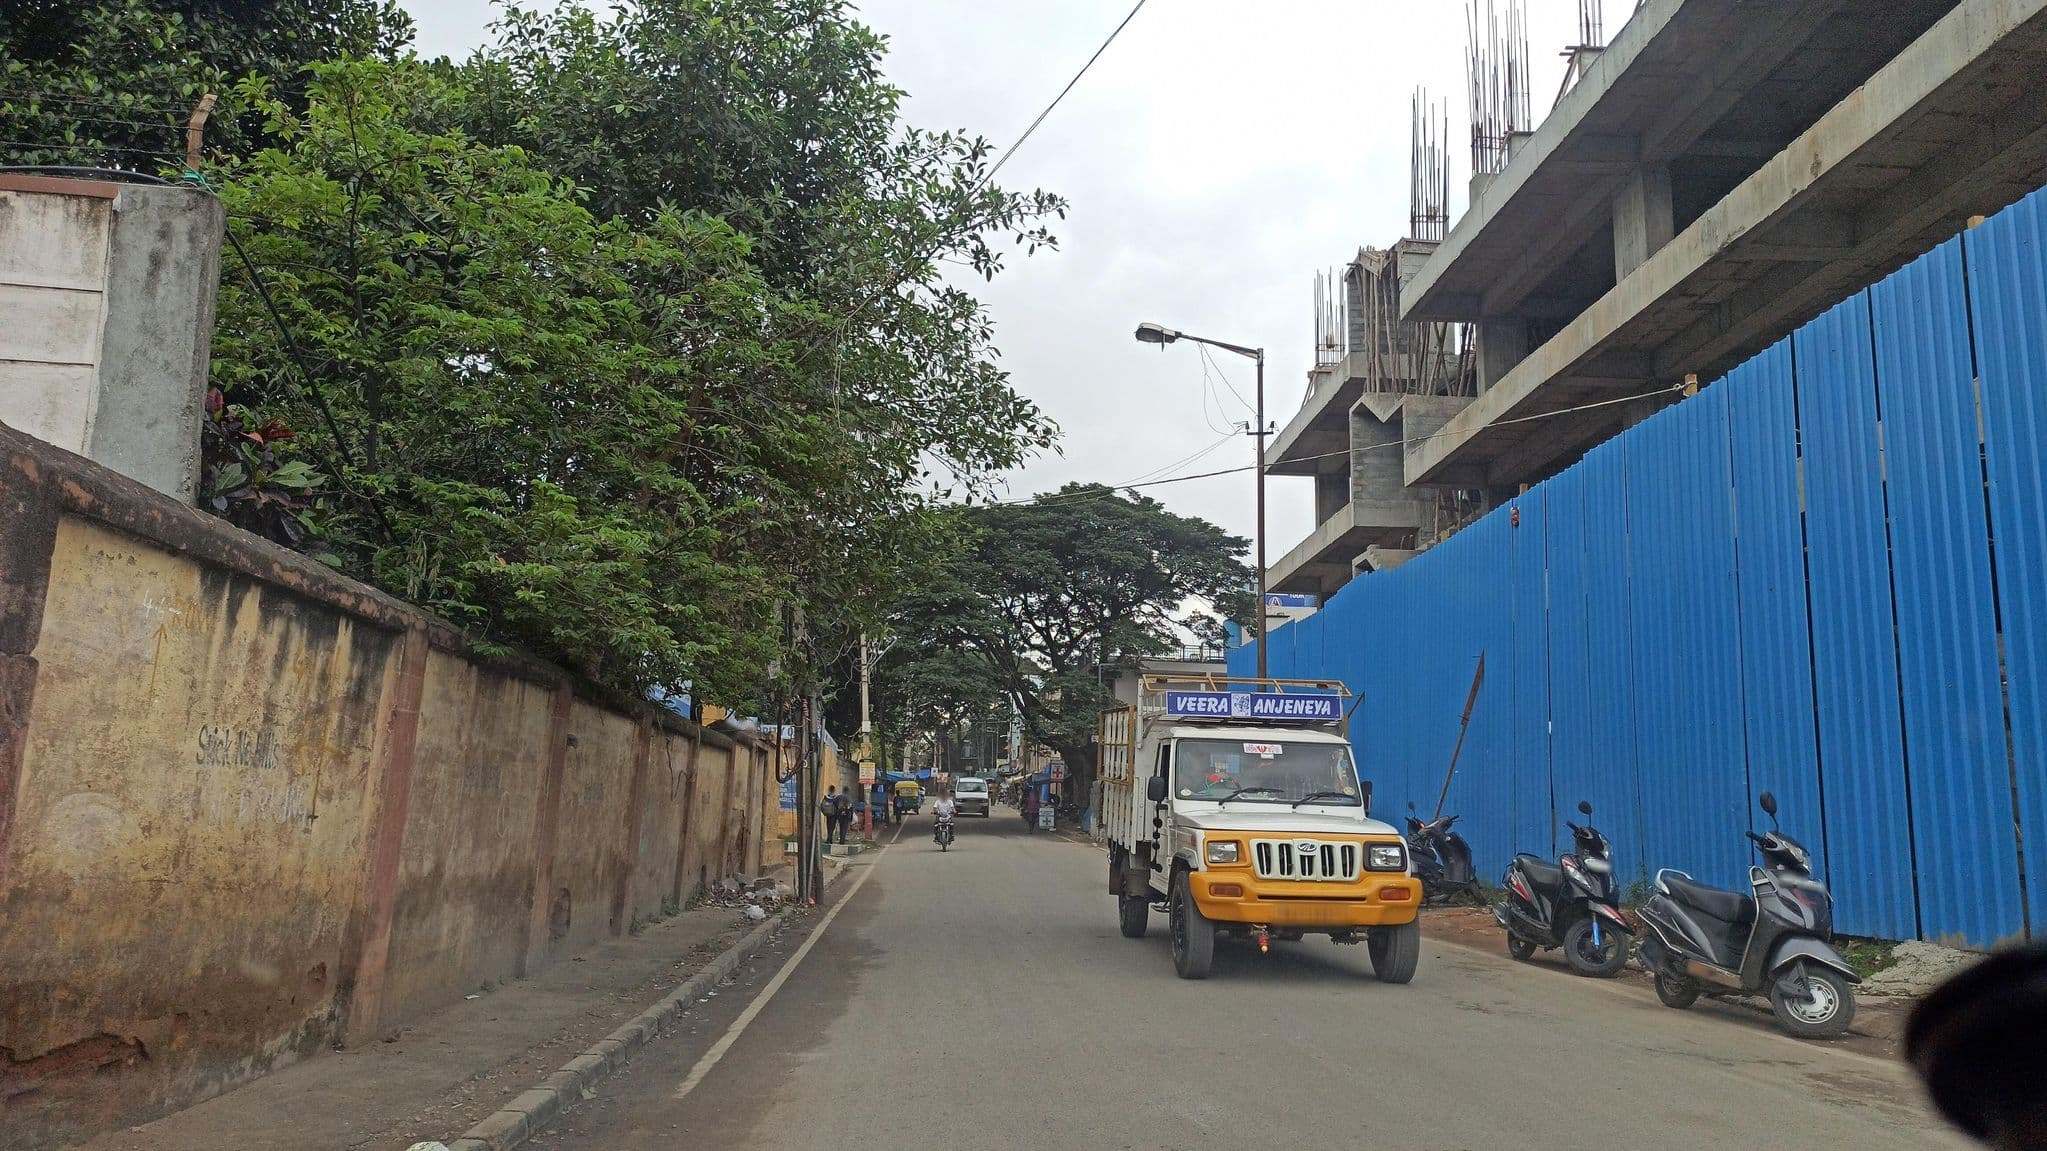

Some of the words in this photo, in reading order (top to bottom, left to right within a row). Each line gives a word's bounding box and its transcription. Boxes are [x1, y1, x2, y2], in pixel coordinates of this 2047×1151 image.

[1176, 696, 1228, 713] VEERA
[1254, 698, 1332, 716] ANJENEYA
[196, 723, 233, 767] Stick
